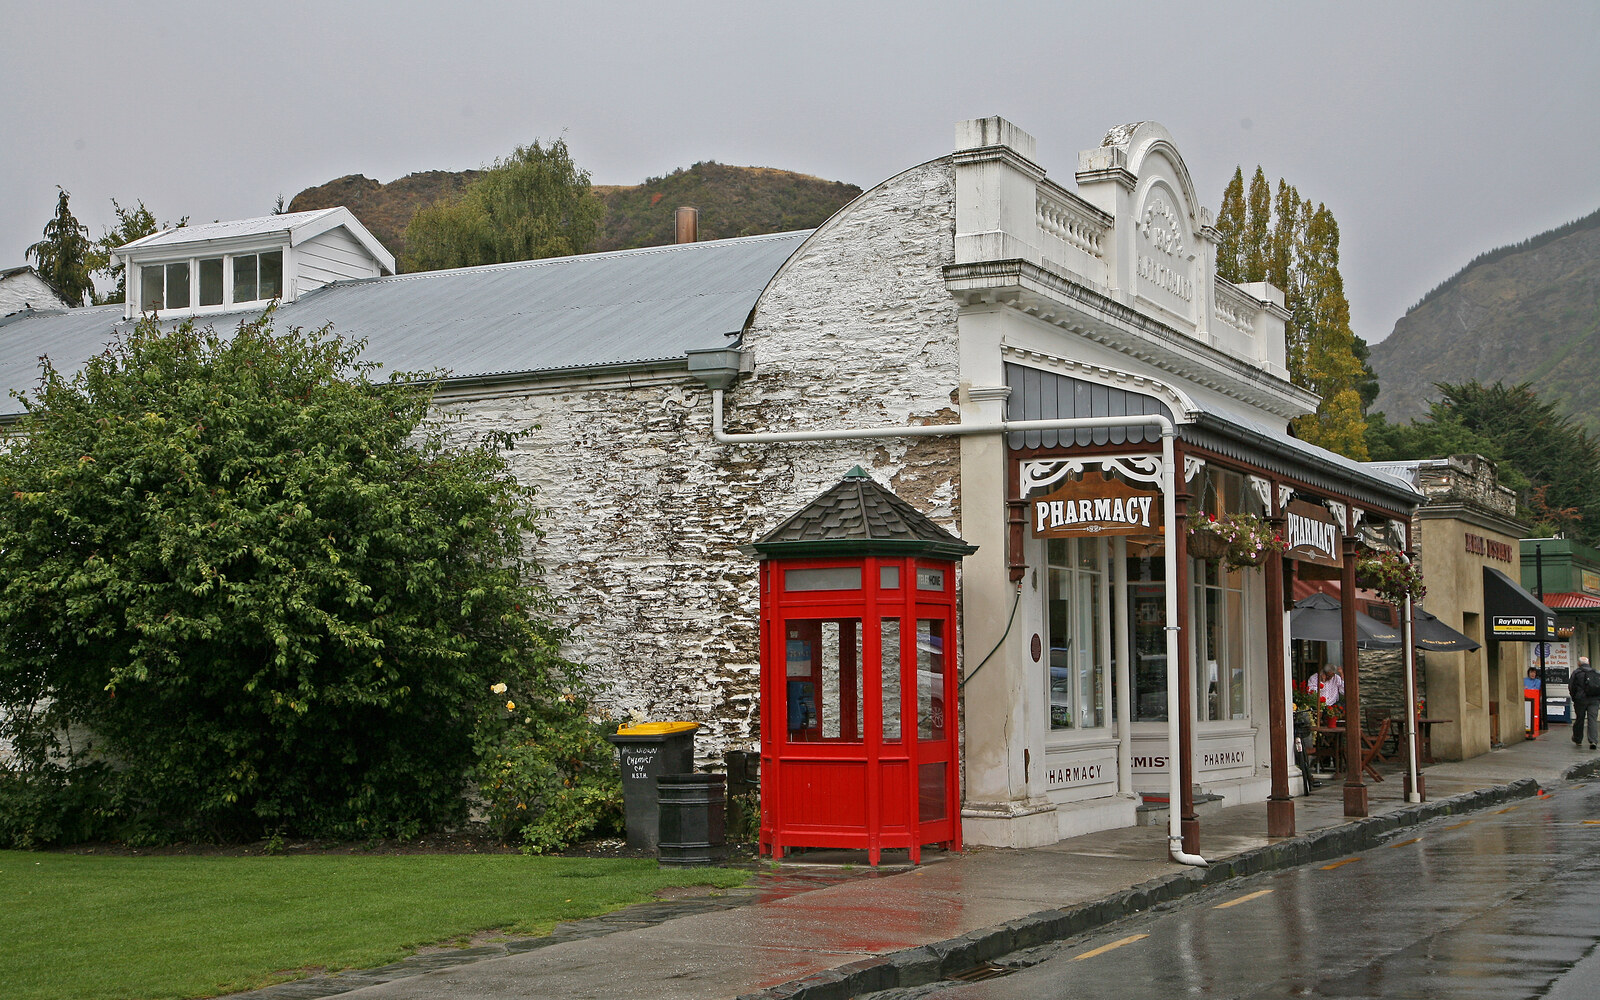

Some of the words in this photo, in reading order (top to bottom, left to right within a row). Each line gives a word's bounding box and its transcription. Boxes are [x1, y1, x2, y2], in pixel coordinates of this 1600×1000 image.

[1036, 496, 1152, 532] PHARMACY
[1287, 512, 1336, 561] PHARMACY
[1204, 751, 1245, 766] PHARMACY
[1045, 764, 1102, 784] HARMACY
